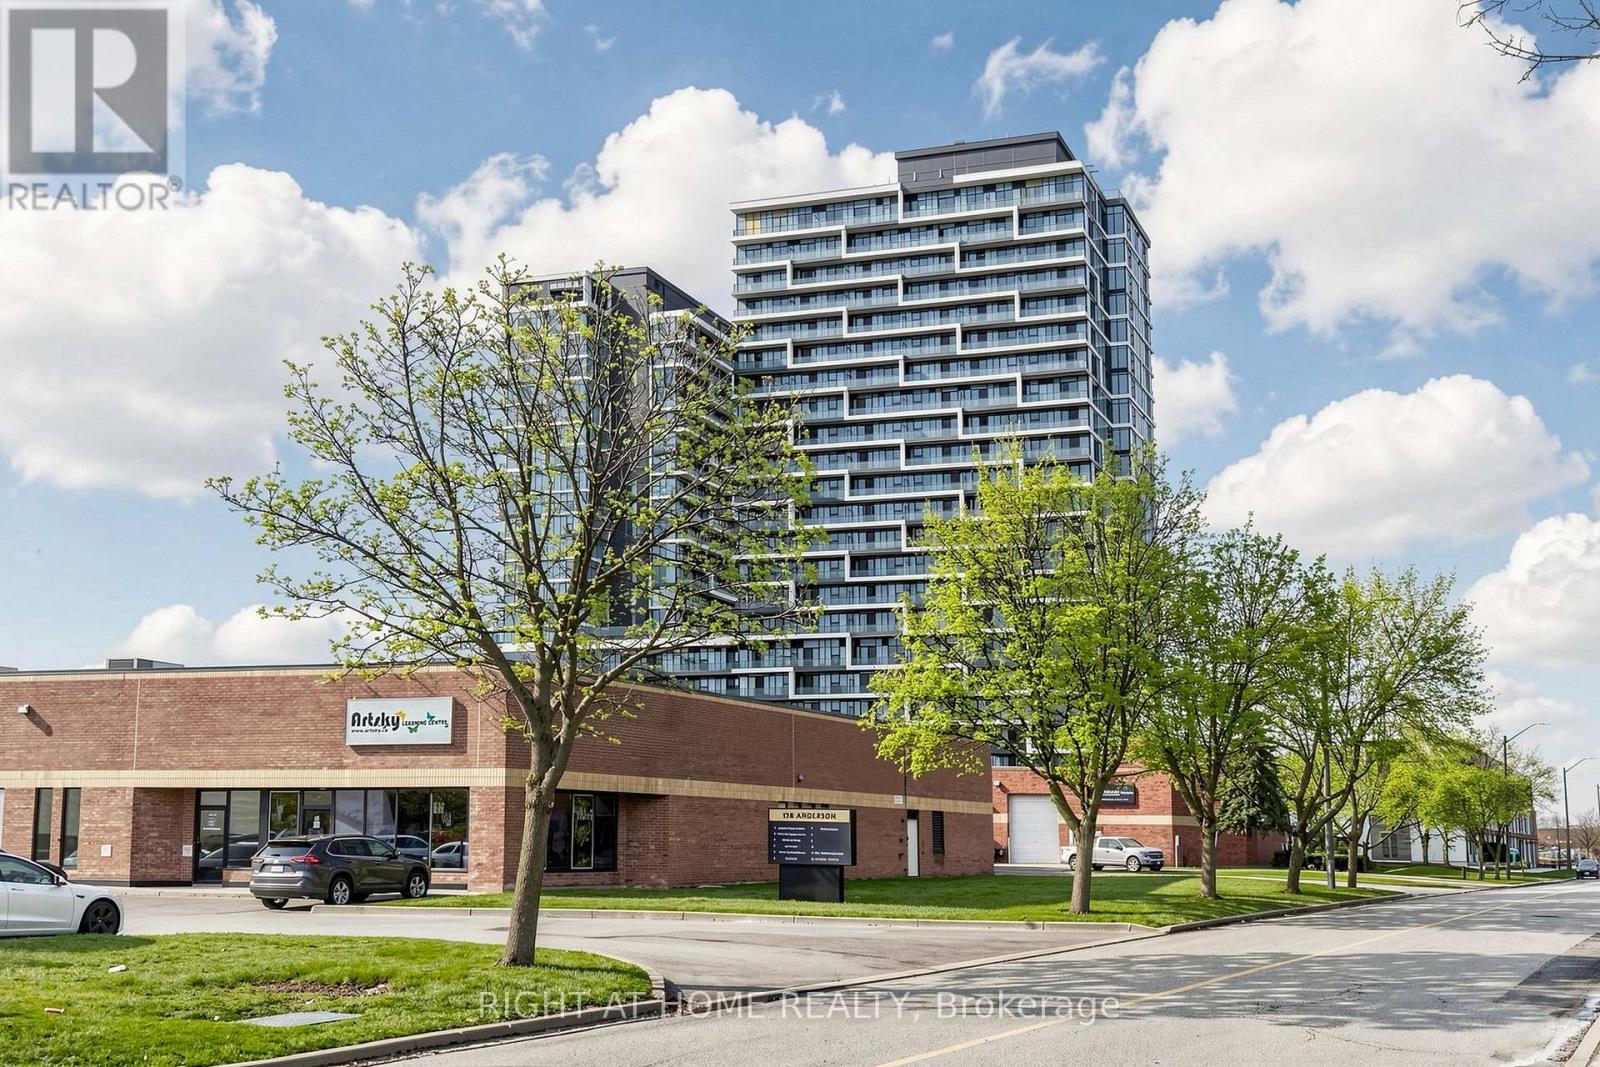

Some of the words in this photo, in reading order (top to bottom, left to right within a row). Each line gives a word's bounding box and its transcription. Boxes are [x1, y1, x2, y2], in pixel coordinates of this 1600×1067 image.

[351, 711, 400, 731] Artsky
[402, 719, 427, 727] LEARNING
[796, 812, 837, 820] ANDERSON
